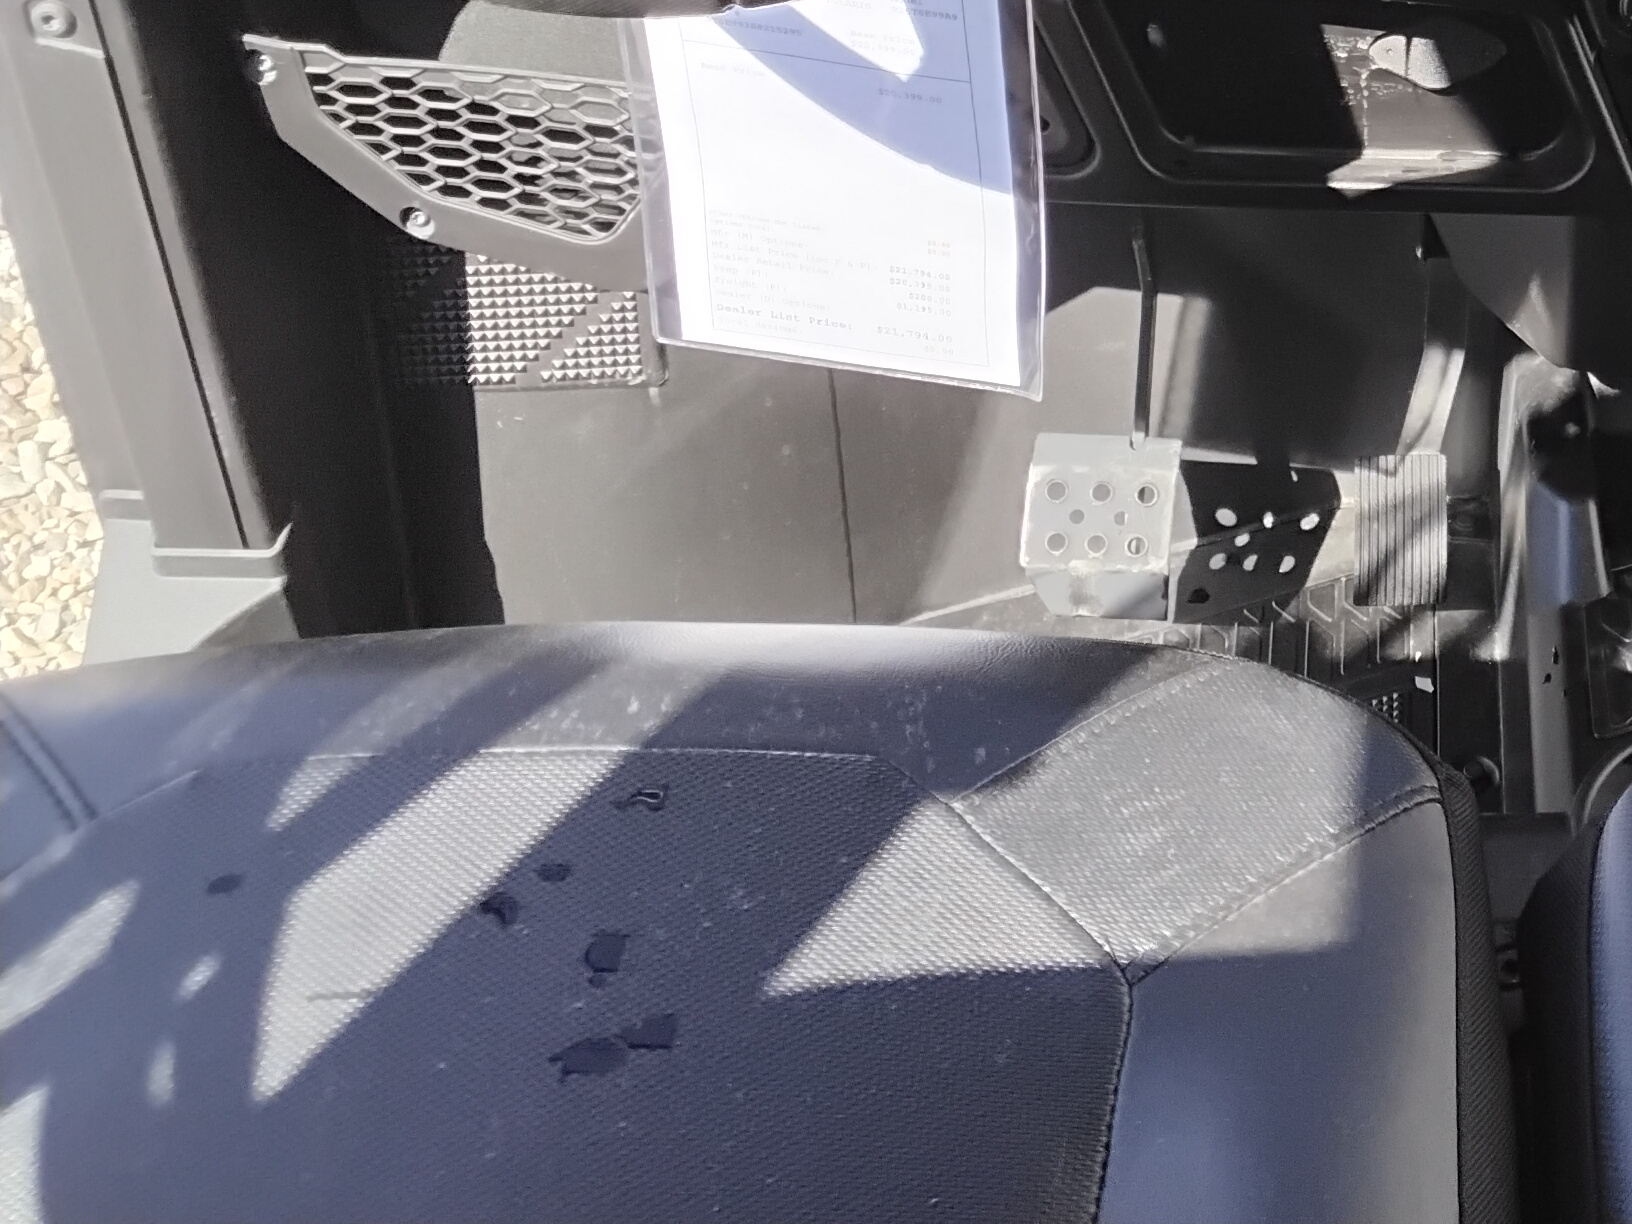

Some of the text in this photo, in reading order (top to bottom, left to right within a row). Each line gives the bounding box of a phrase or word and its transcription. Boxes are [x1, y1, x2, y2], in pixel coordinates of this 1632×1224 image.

[908, 292, 951, 306] $200.00
[716, 303, 953, 344] Dealer List Price: $21,794.00
